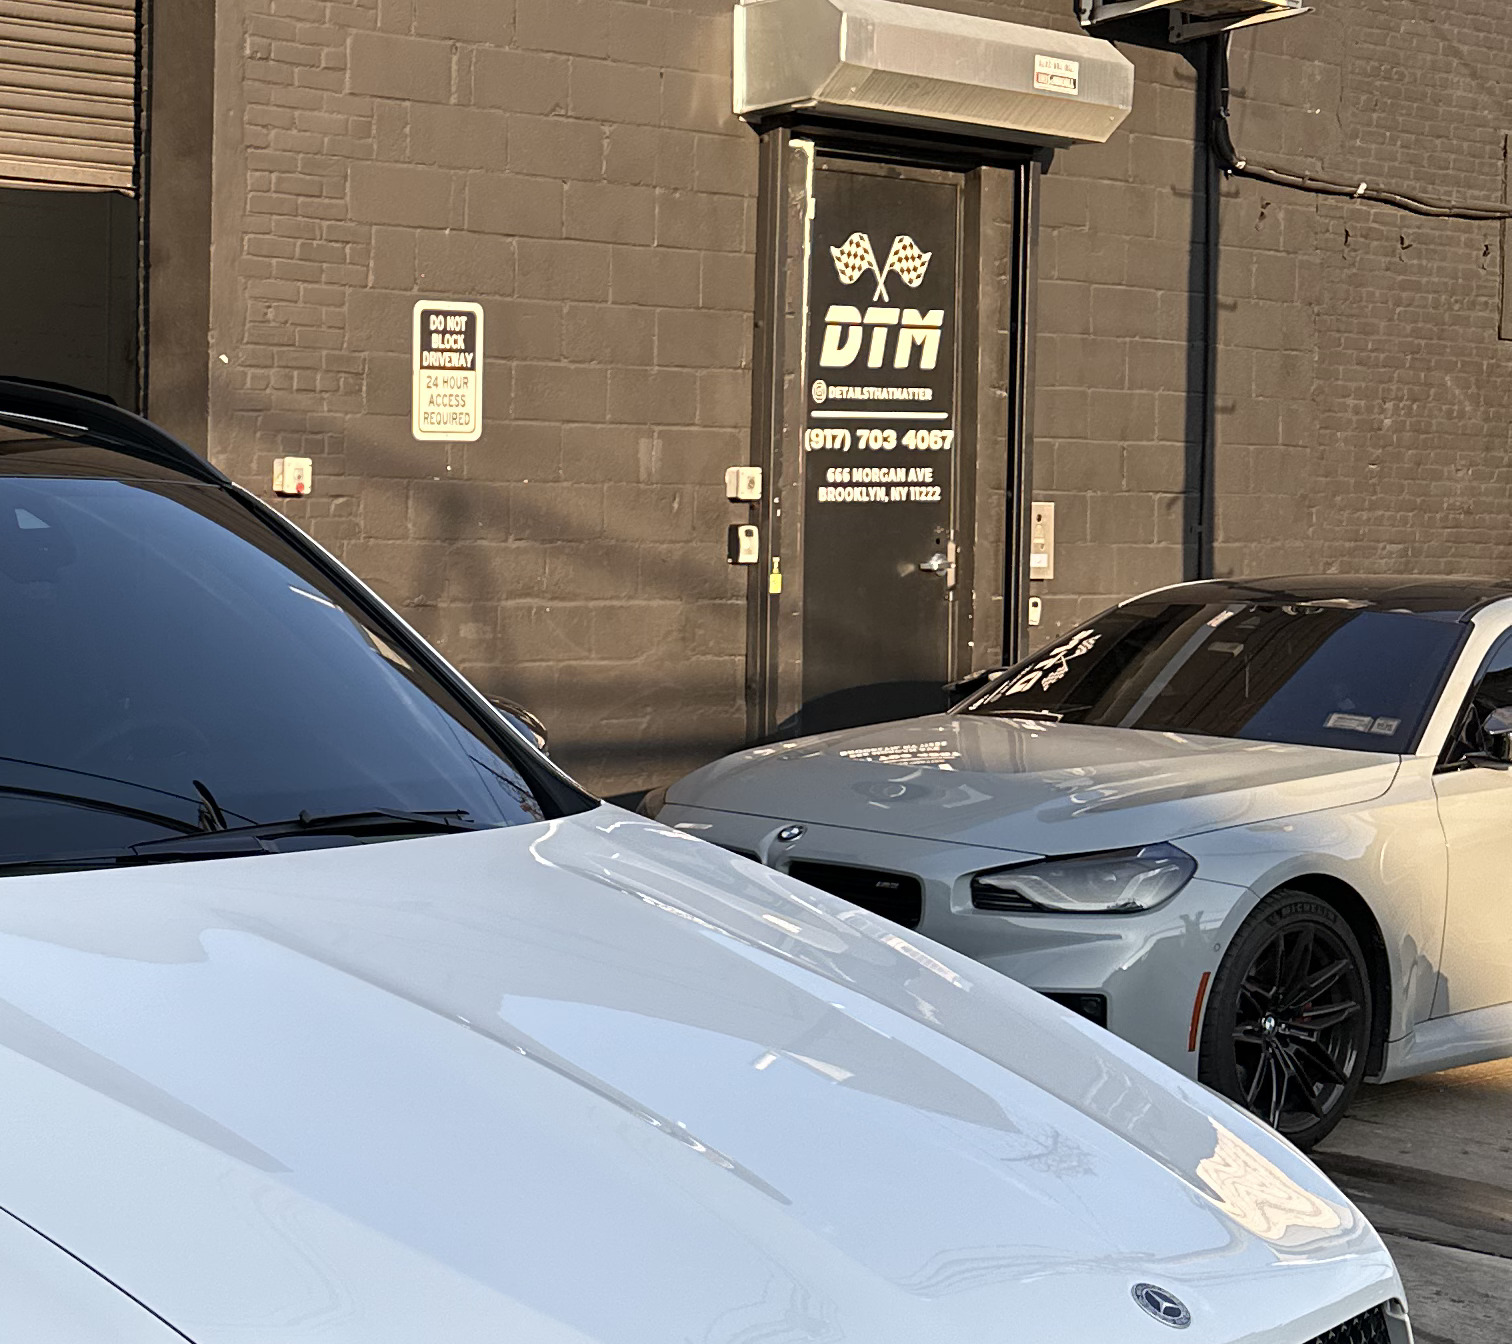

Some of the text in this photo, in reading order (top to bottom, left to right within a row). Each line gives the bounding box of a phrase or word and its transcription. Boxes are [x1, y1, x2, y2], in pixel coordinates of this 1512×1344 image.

[429, 314, 467, 332] DO NOT
[431, 333, 465, 350] BLOCK
[819, 304, 945, 370] DTM
[422, 351, 474, 368] DRIVEWAY
[426, 375, 469, 389] 24 HOUR
[428, 394, 466, 408] ACCESS
[423, 411, 471, 426] REQUIRED
[804, 428, 955, 452] (917) 703 4067
[826, 467, 933, 483] 666 MORGAN AVE
[818, 486, 942, 503] BROOKLYN, NY 11222
